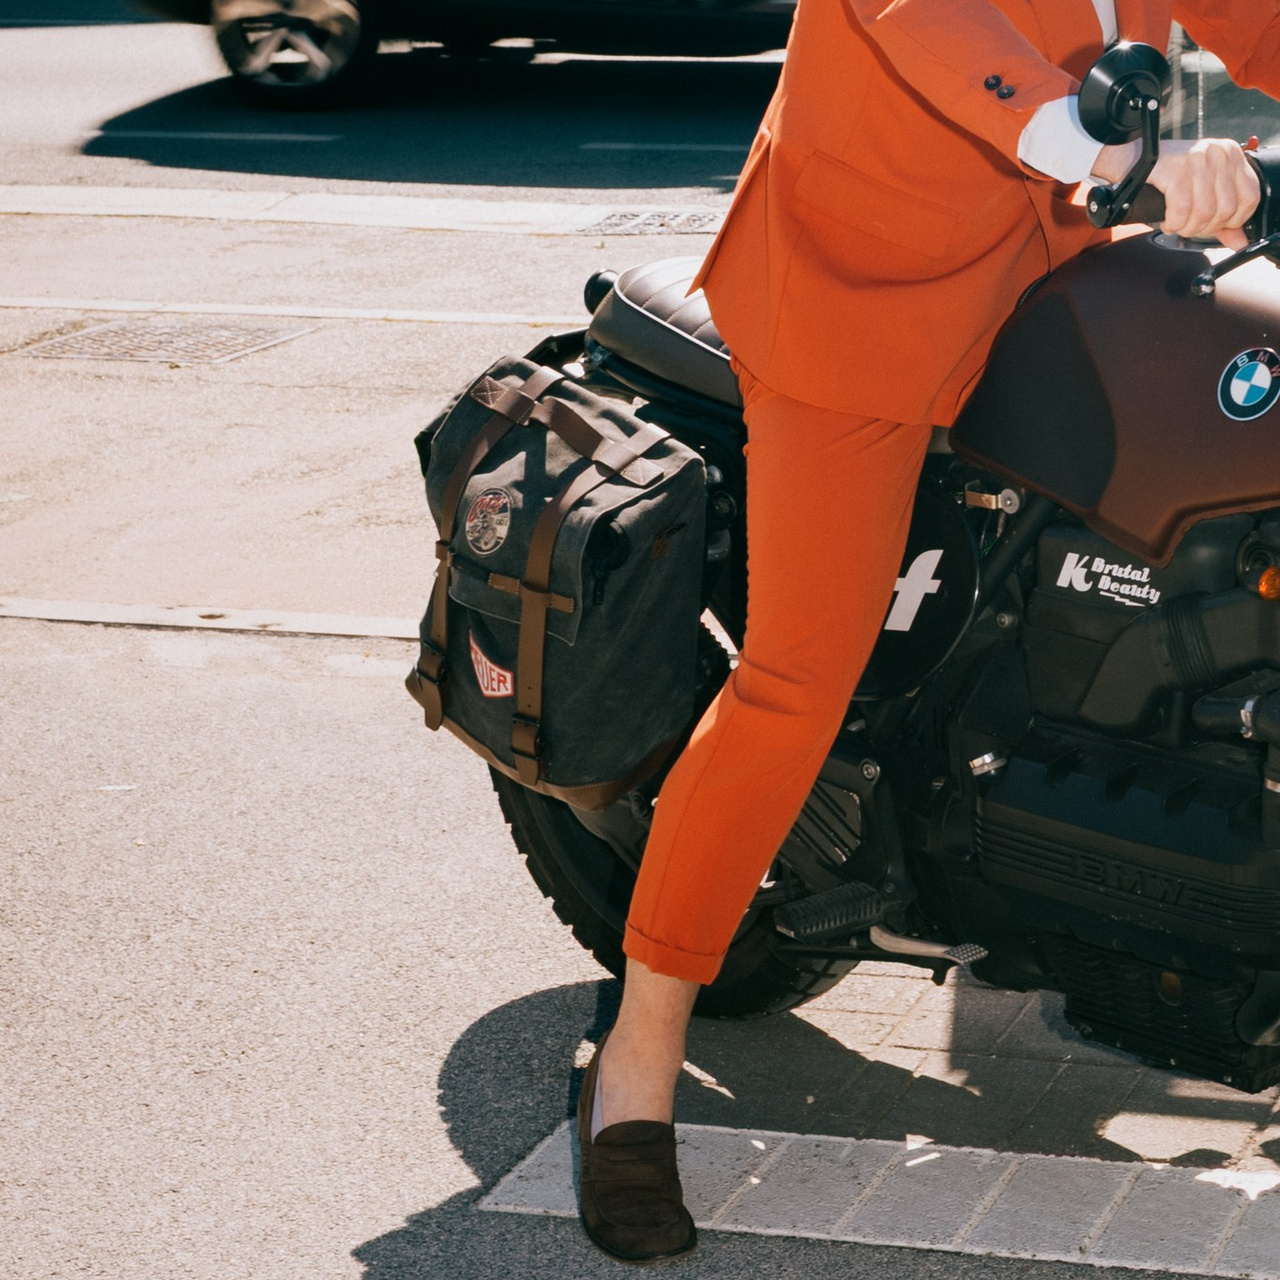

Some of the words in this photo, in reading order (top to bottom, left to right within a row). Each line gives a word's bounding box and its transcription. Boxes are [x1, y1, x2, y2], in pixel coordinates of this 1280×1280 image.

[1056, 552, 1094, 592] K
[1091, 557, 1150, 583] Brutal
[1097, 576, 1160, 604] Beauty
